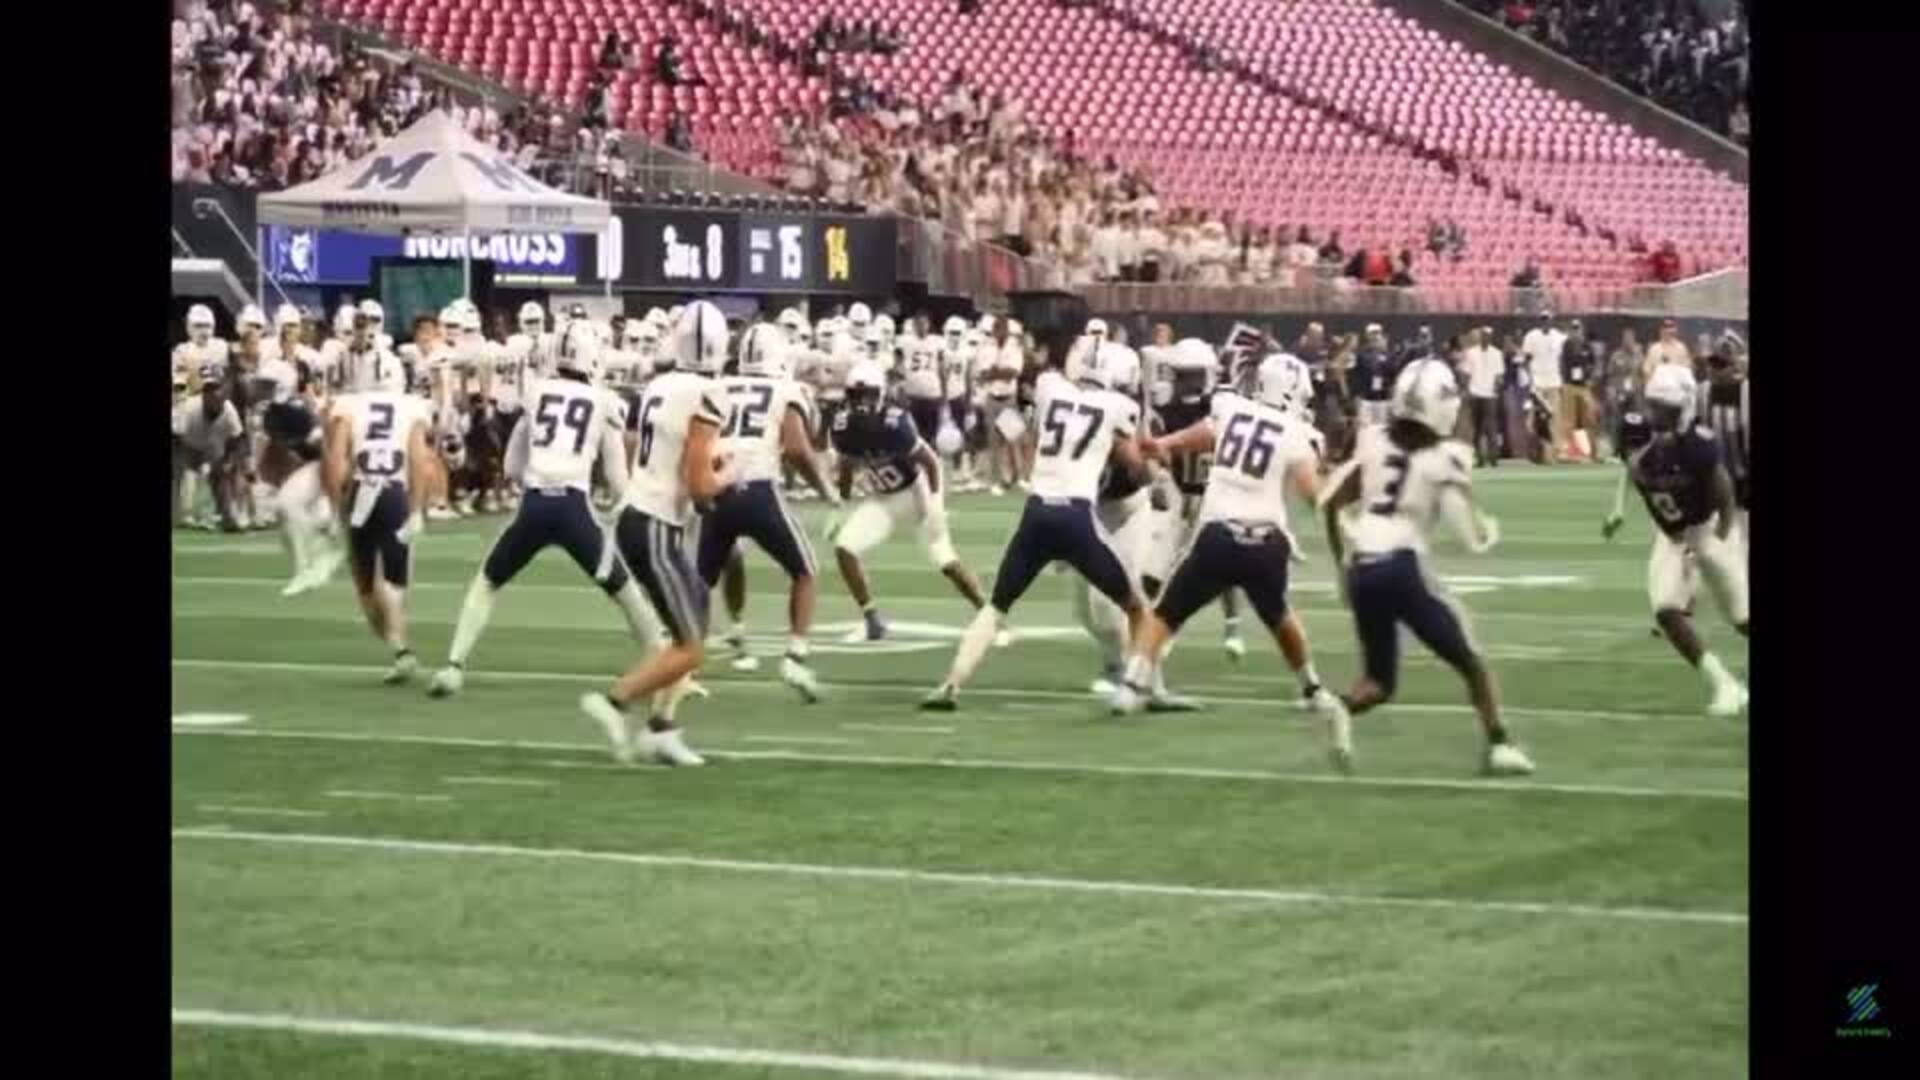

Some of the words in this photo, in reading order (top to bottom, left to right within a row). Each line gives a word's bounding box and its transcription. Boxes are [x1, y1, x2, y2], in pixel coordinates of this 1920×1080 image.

[346, 152, 436, 189] M
[365, 403, 395, 440] 2
[533, 394, 594, 455] 59
[1039, 399, 1104, 460] 57
[1216, 413, 1284, 480] 66
